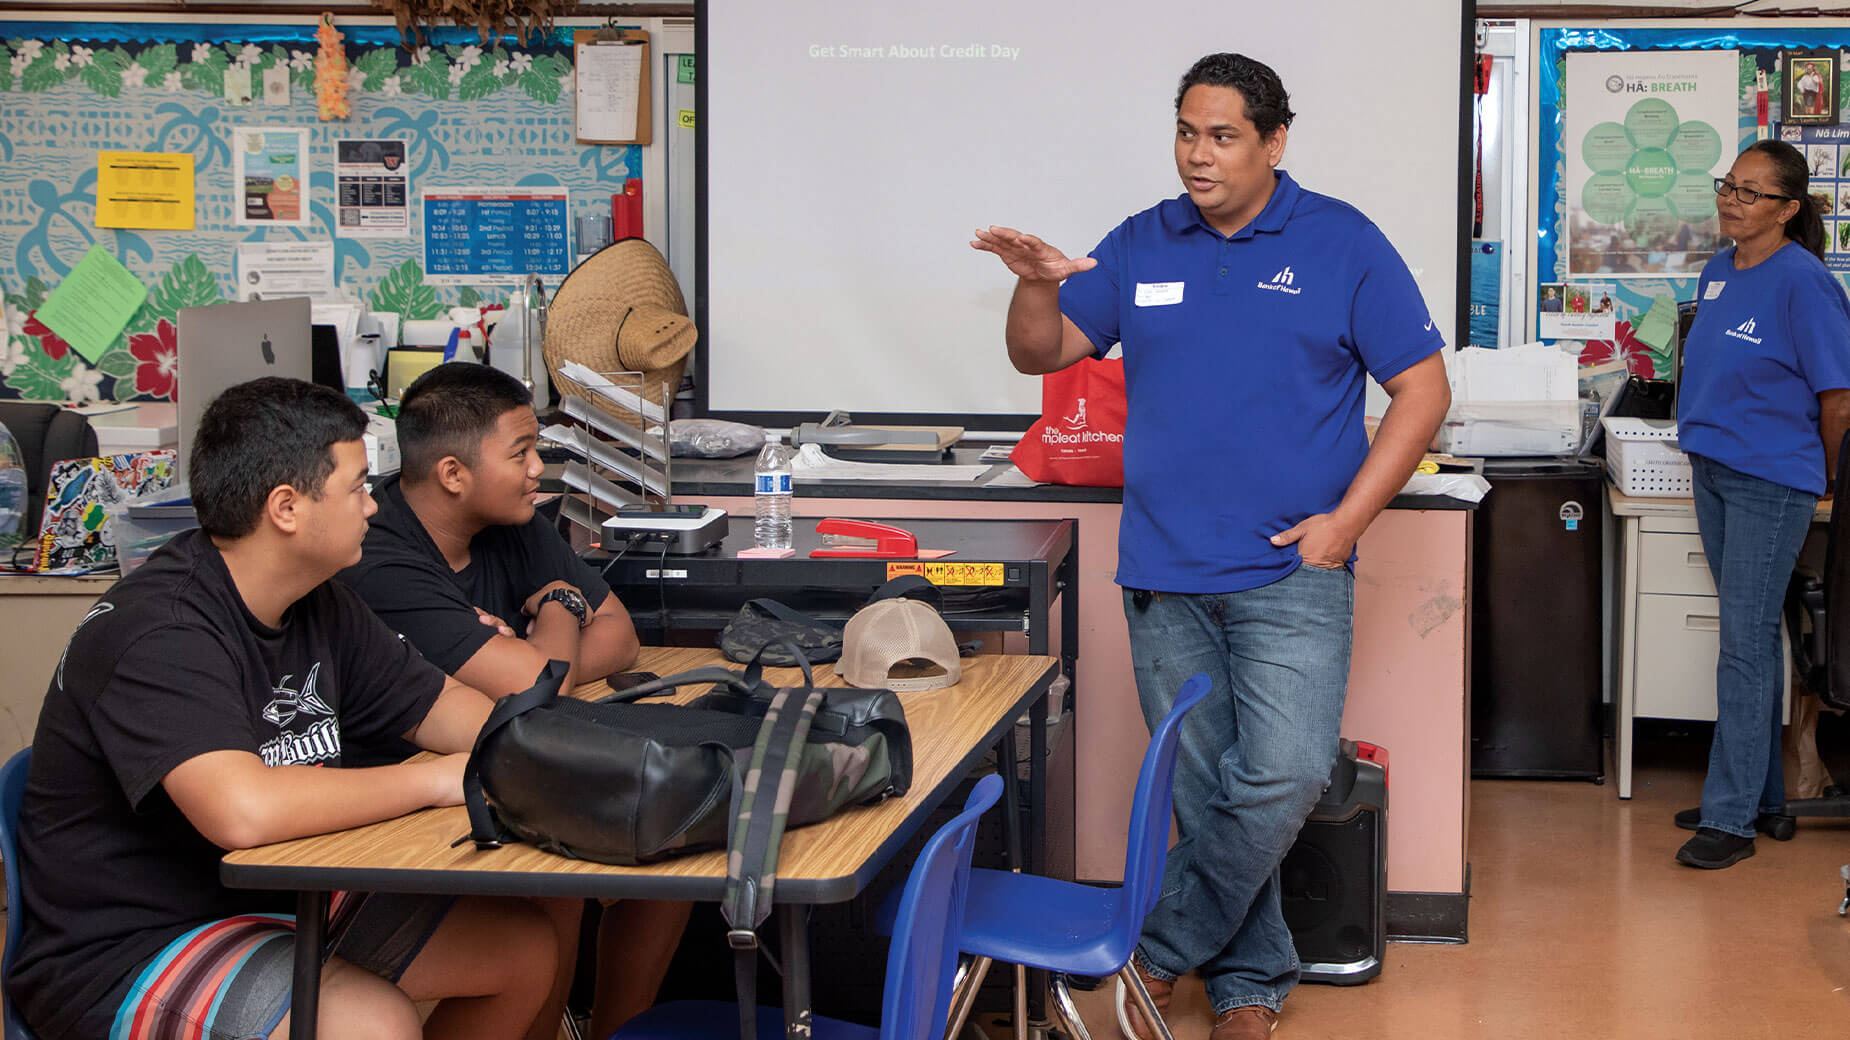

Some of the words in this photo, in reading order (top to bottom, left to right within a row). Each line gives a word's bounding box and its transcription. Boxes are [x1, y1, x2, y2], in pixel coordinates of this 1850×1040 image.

[809, 44, 834, 58] Get
[839, 44, 884, 58] Smart
[887, 44, 935, 58] About
[940, 44, 987, 58] Credit
[991, 44, 1019, 61] Day
[683, 58, 695, 68] LE
[1651, 82, 1697, 92] BREATH
[1045, 426, 1060, 435] the
[1082, 430, 1124, 443] kitchen
